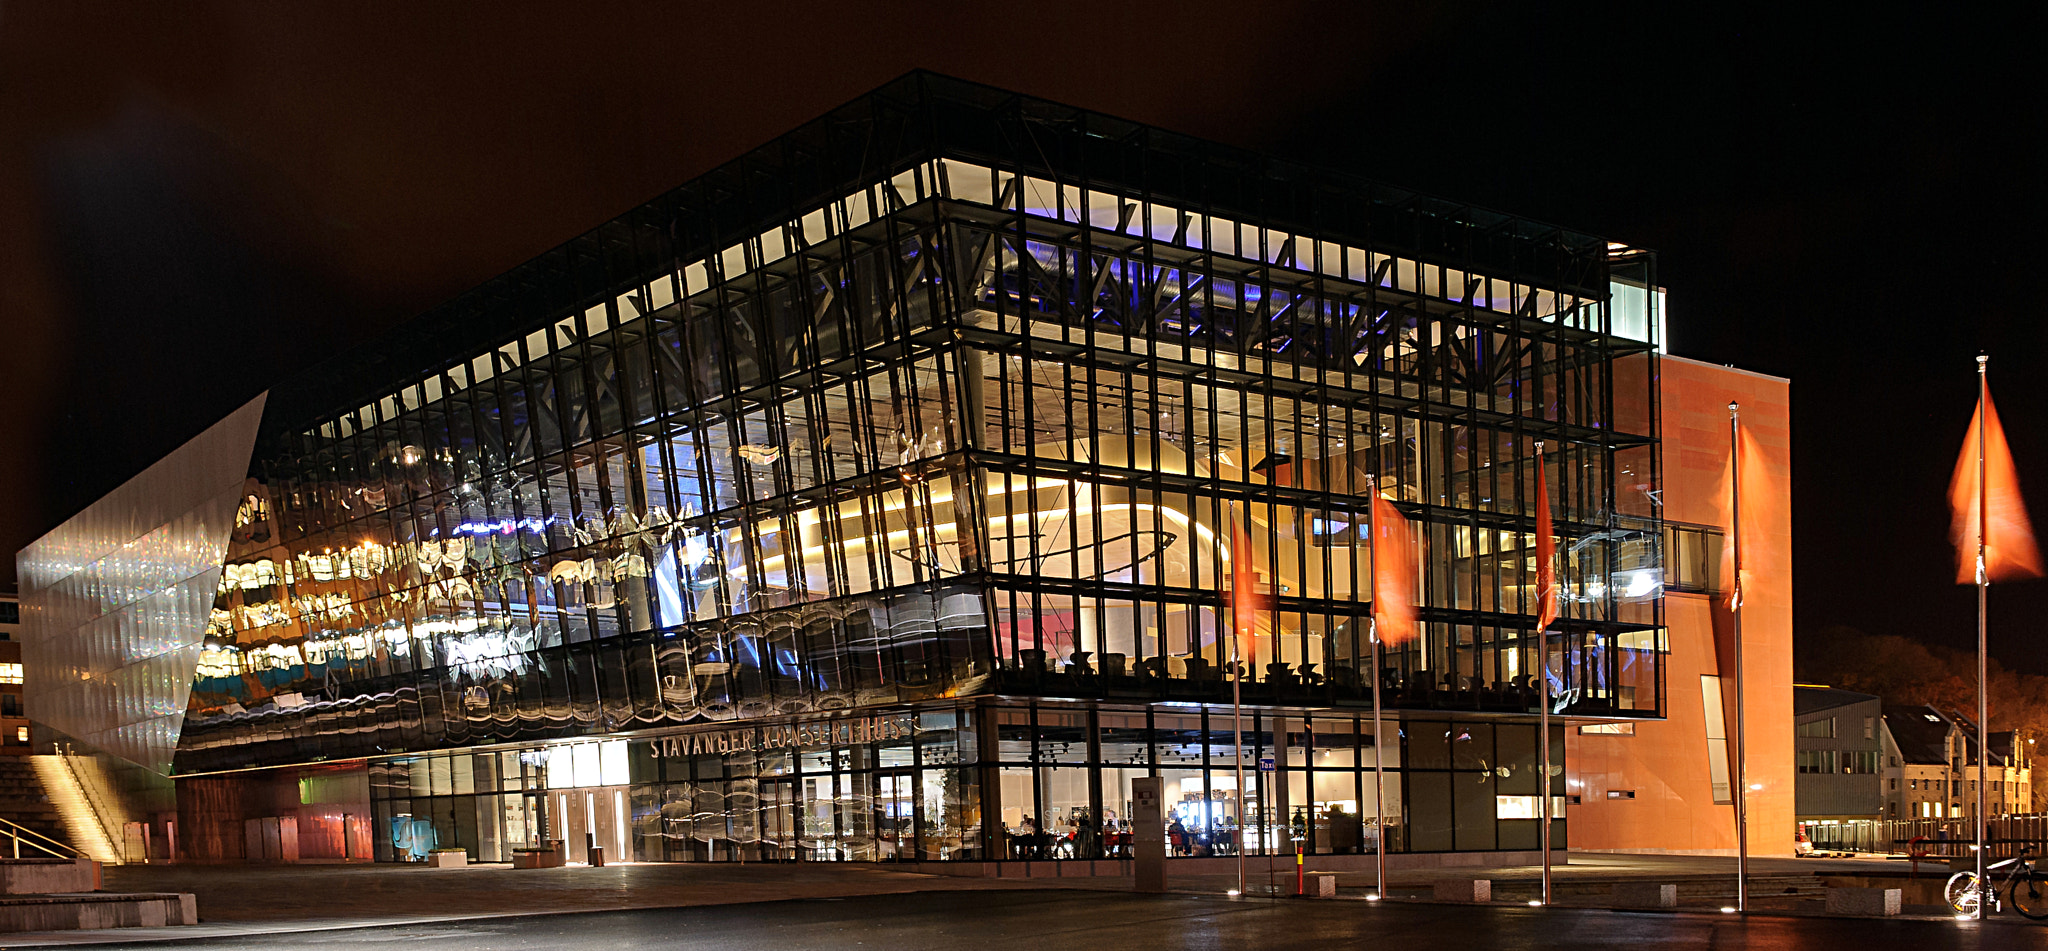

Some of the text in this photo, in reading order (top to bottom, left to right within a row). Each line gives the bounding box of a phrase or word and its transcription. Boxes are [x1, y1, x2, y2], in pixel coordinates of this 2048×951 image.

[651, 716, 901, 758] STAVANGER KONSERTHUS
[1261, 761, 1275, 769] Taxi
